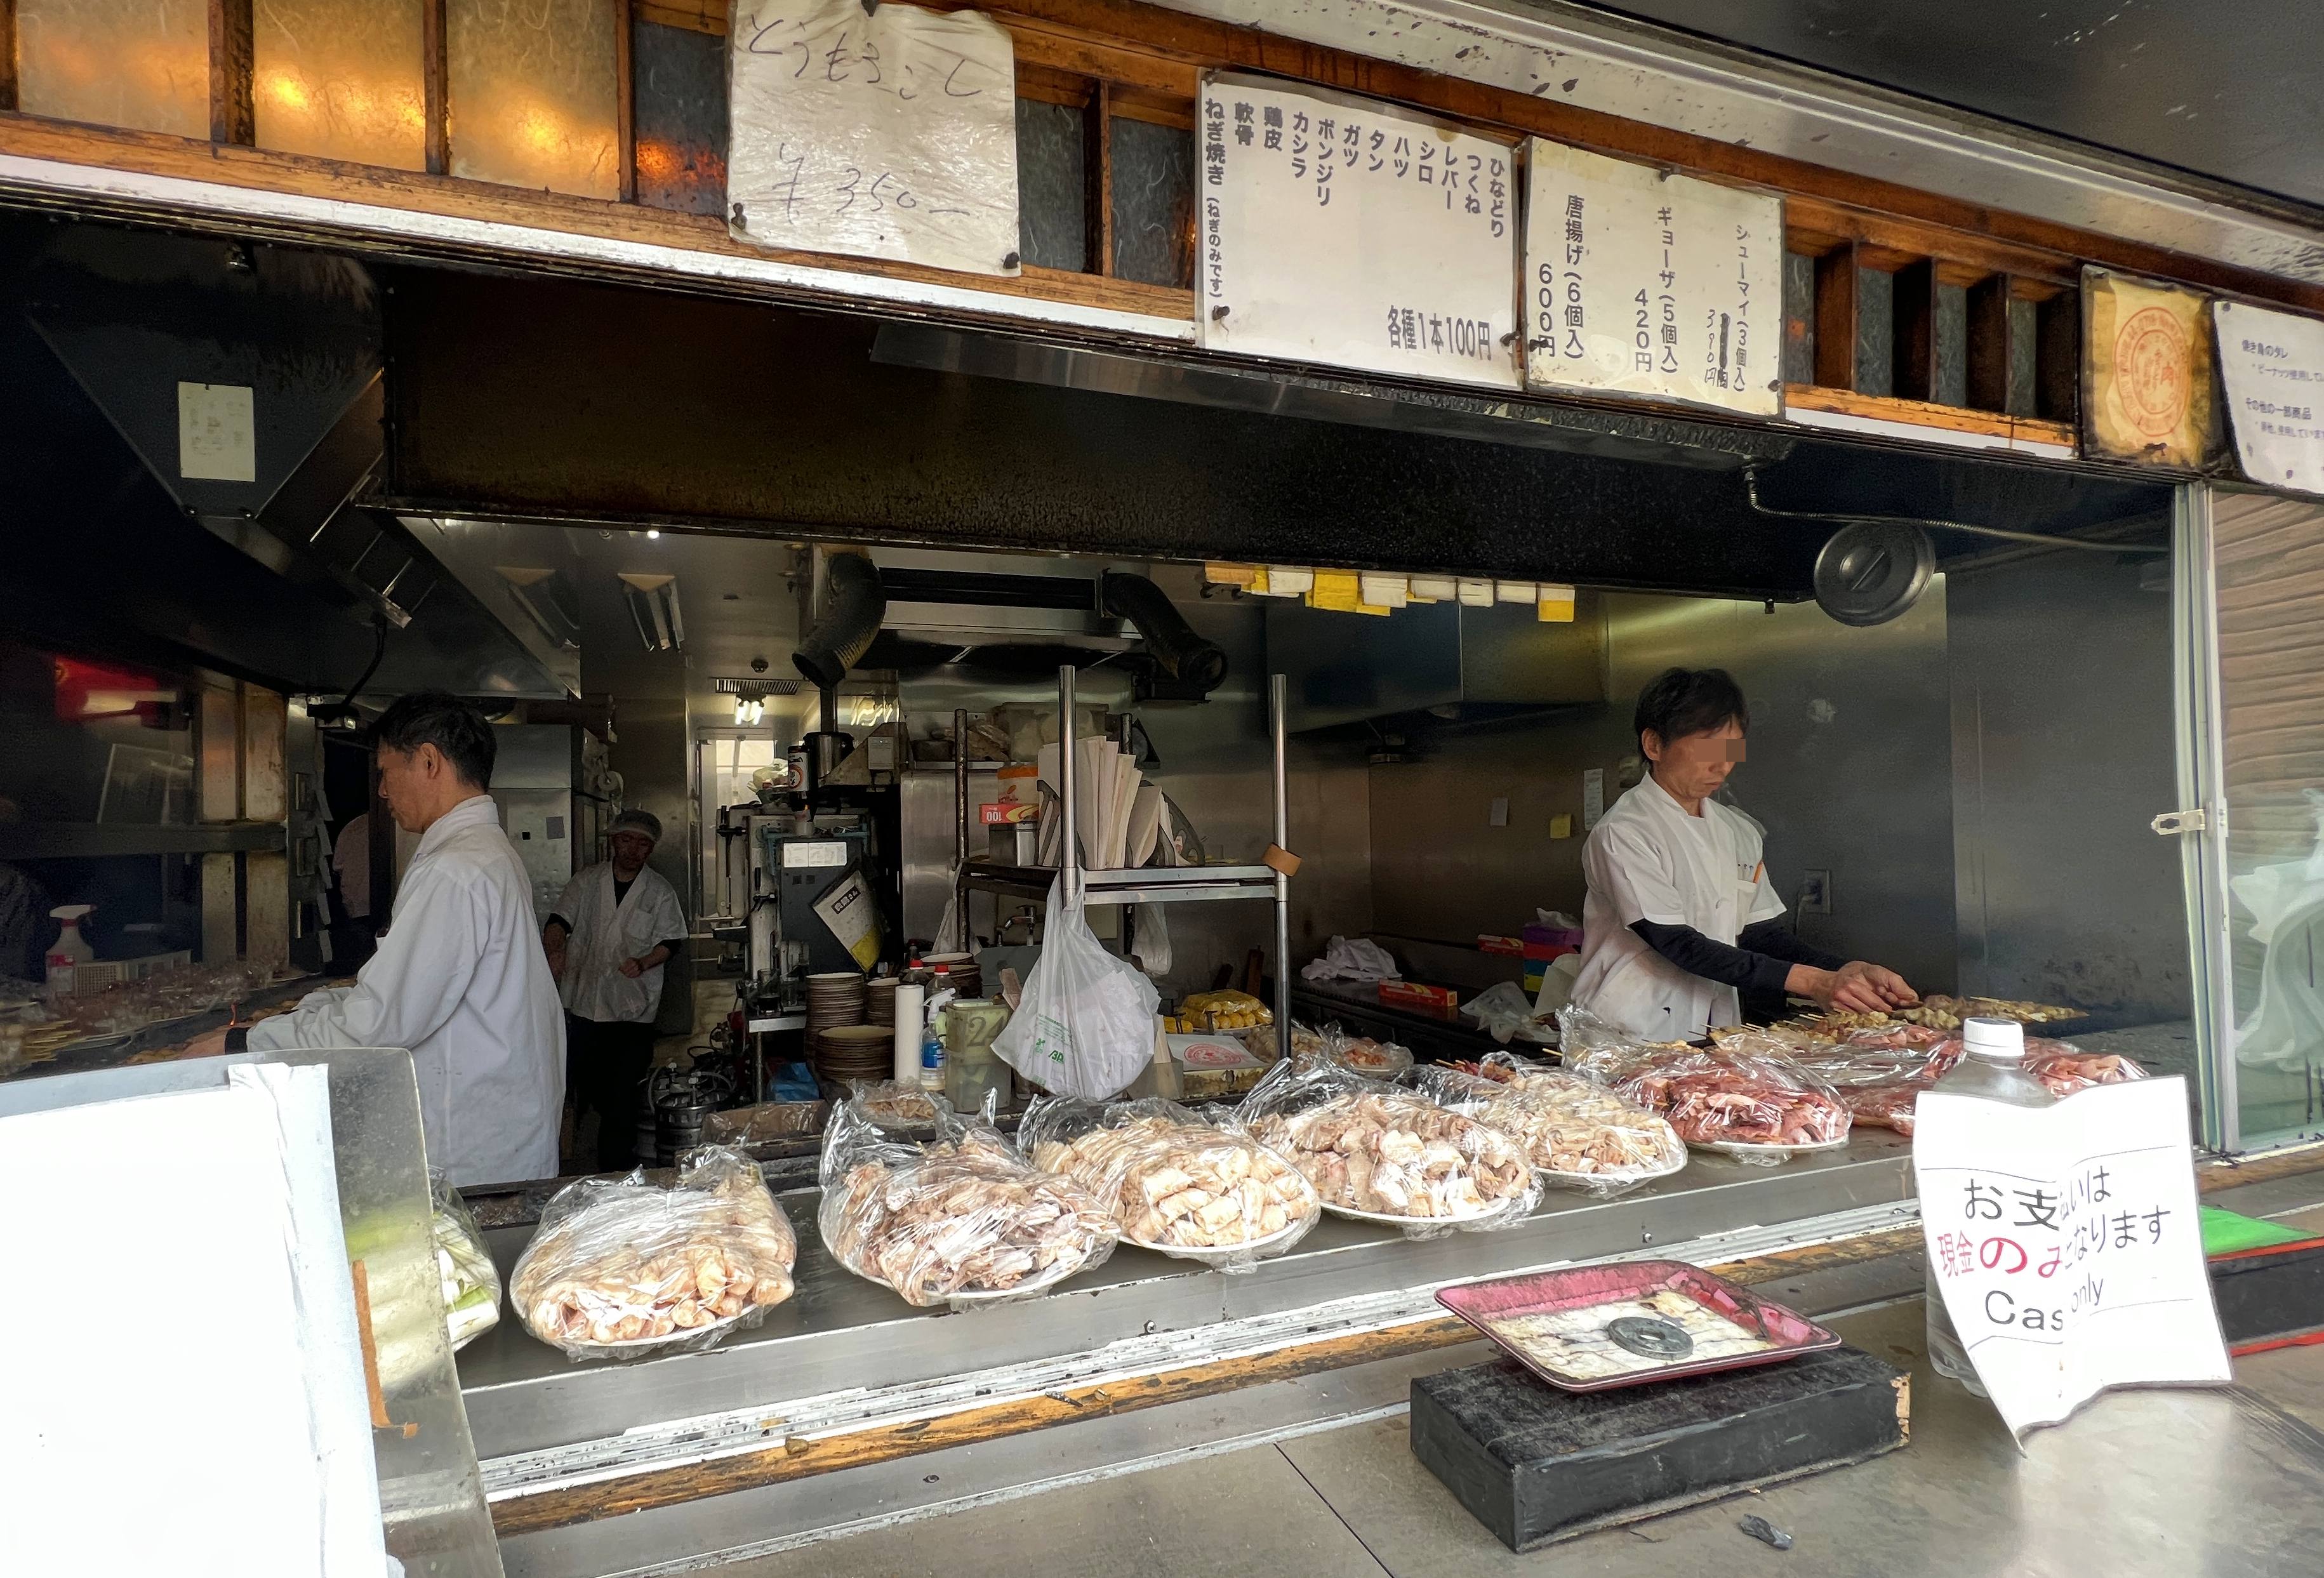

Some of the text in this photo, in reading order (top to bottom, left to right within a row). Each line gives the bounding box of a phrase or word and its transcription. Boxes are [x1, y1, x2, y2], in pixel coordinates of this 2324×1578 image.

[1234, 101, 1254, 146] 軟骨
[1291, 111, 1309, 178] カシラ
[1343, 124, 1361, 168] ガツ
[1368, 129, 1385, 172] タン
[1317, 118, 1335, 207] ボンジリ
[1393, 136, 1411, 178] ハツ
[1418, 140, 1435, 185] シロ
[1441, 145, 1459, 210] レバー
[1464, 154, 1482, 215] つくね
[1490, 158, 1505, 238] ひなどり
[1563, 194, 1585, 359] 唐揚げ(6個入)
[1388, 304, 1491, 361] 各種1本100円
[1537, 263, 1555, 357] 600円
[1635, 288, 1652, 372] 420円
[1985, 1290, 2064, 1331] Cas
